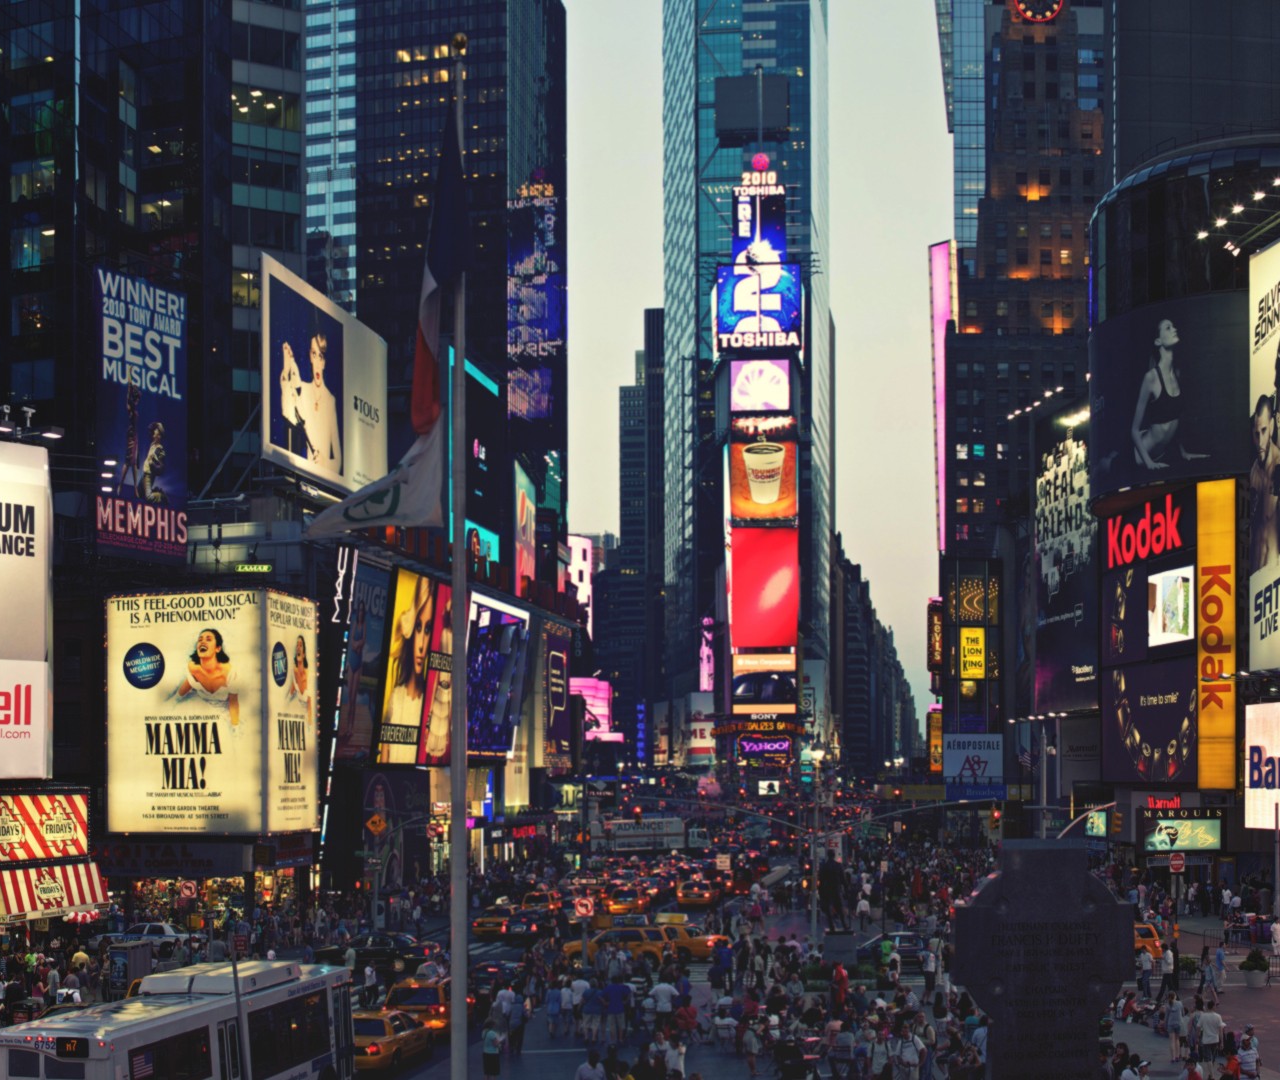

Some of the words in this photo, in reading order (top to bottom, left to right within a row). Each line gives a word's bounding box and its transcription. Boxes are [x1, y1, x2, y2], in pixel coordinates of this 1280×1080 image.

[733, 185, 785, 196] TOSHIBA
[742, 171, 777, 185] 2010
[98, 268, 184, 320] WINNER!
[103, 297, 126, 319] 2010
[128, 304, 152, 328] TONY
[153, 313, 181, 337] AWARD
[103, 316, 181, 375] BEST
[719, 332, 800, 348] TOSHIBA
[103, 357, 181, 400] MUSICAL
[358, 397, 380, 424] TOUS
[96, 496, 188, 544] MEMPHIS
[1107, 493, 1183, 569] Kodak
[110, 599, 140, 611] "THIS
[209, 592, 258, 608] MUSICAL
[354, 581, 386, 615] HUGE
[130, 612, 140, 624] IS
[143, 612, 151, 623] A
[1260, 611, 1278, 640] LIVE
[966, 637, 979, 645] THE
[1200, 564, 1232, 710] Kodak
[963, 659, 983, 672] KING
[145, 722, 222, 755] MAMMA
[277, 719, 306, 751] MAMMA
[741, 740, 790, 752] YAHOO!
[162, 756, 206, 790] MIA!
[283, 752, 301, 784] MIA!
[616, 821, 664, 832] ADVANCE
[1144, 810, 1222, 819] MARQUIS
[34, 1041, 56, 1050] 6752
